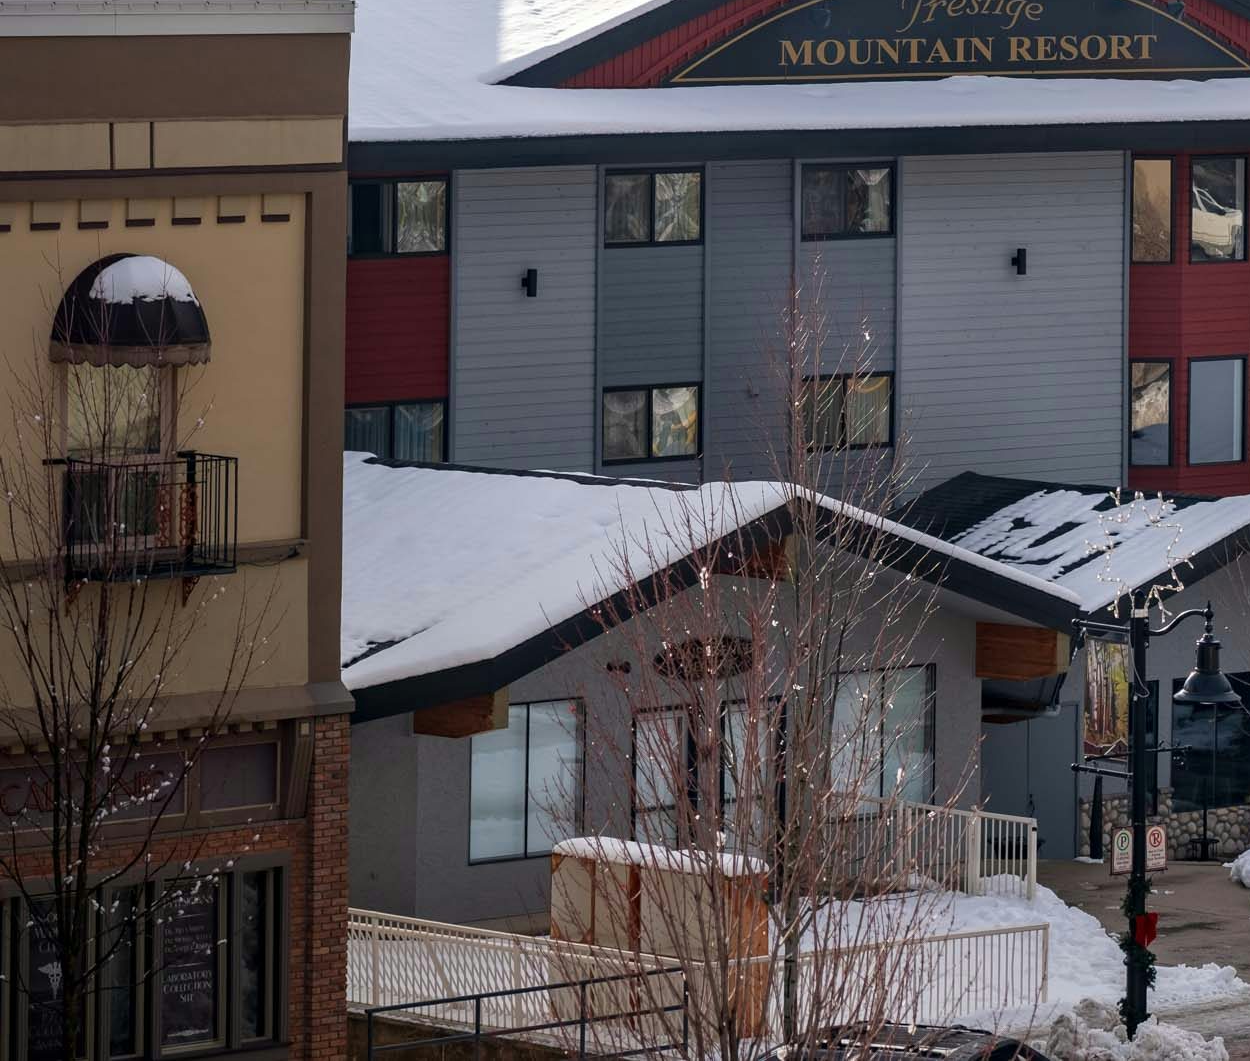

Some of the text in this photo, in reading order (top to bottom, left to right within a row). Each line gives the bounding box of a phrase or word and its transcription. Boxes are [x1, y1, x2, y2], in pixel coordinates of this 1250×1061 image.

[778, 34, 1158, 66] MOUNTAIN RESORT
[162, 980, 213, 995] COLLECTION
